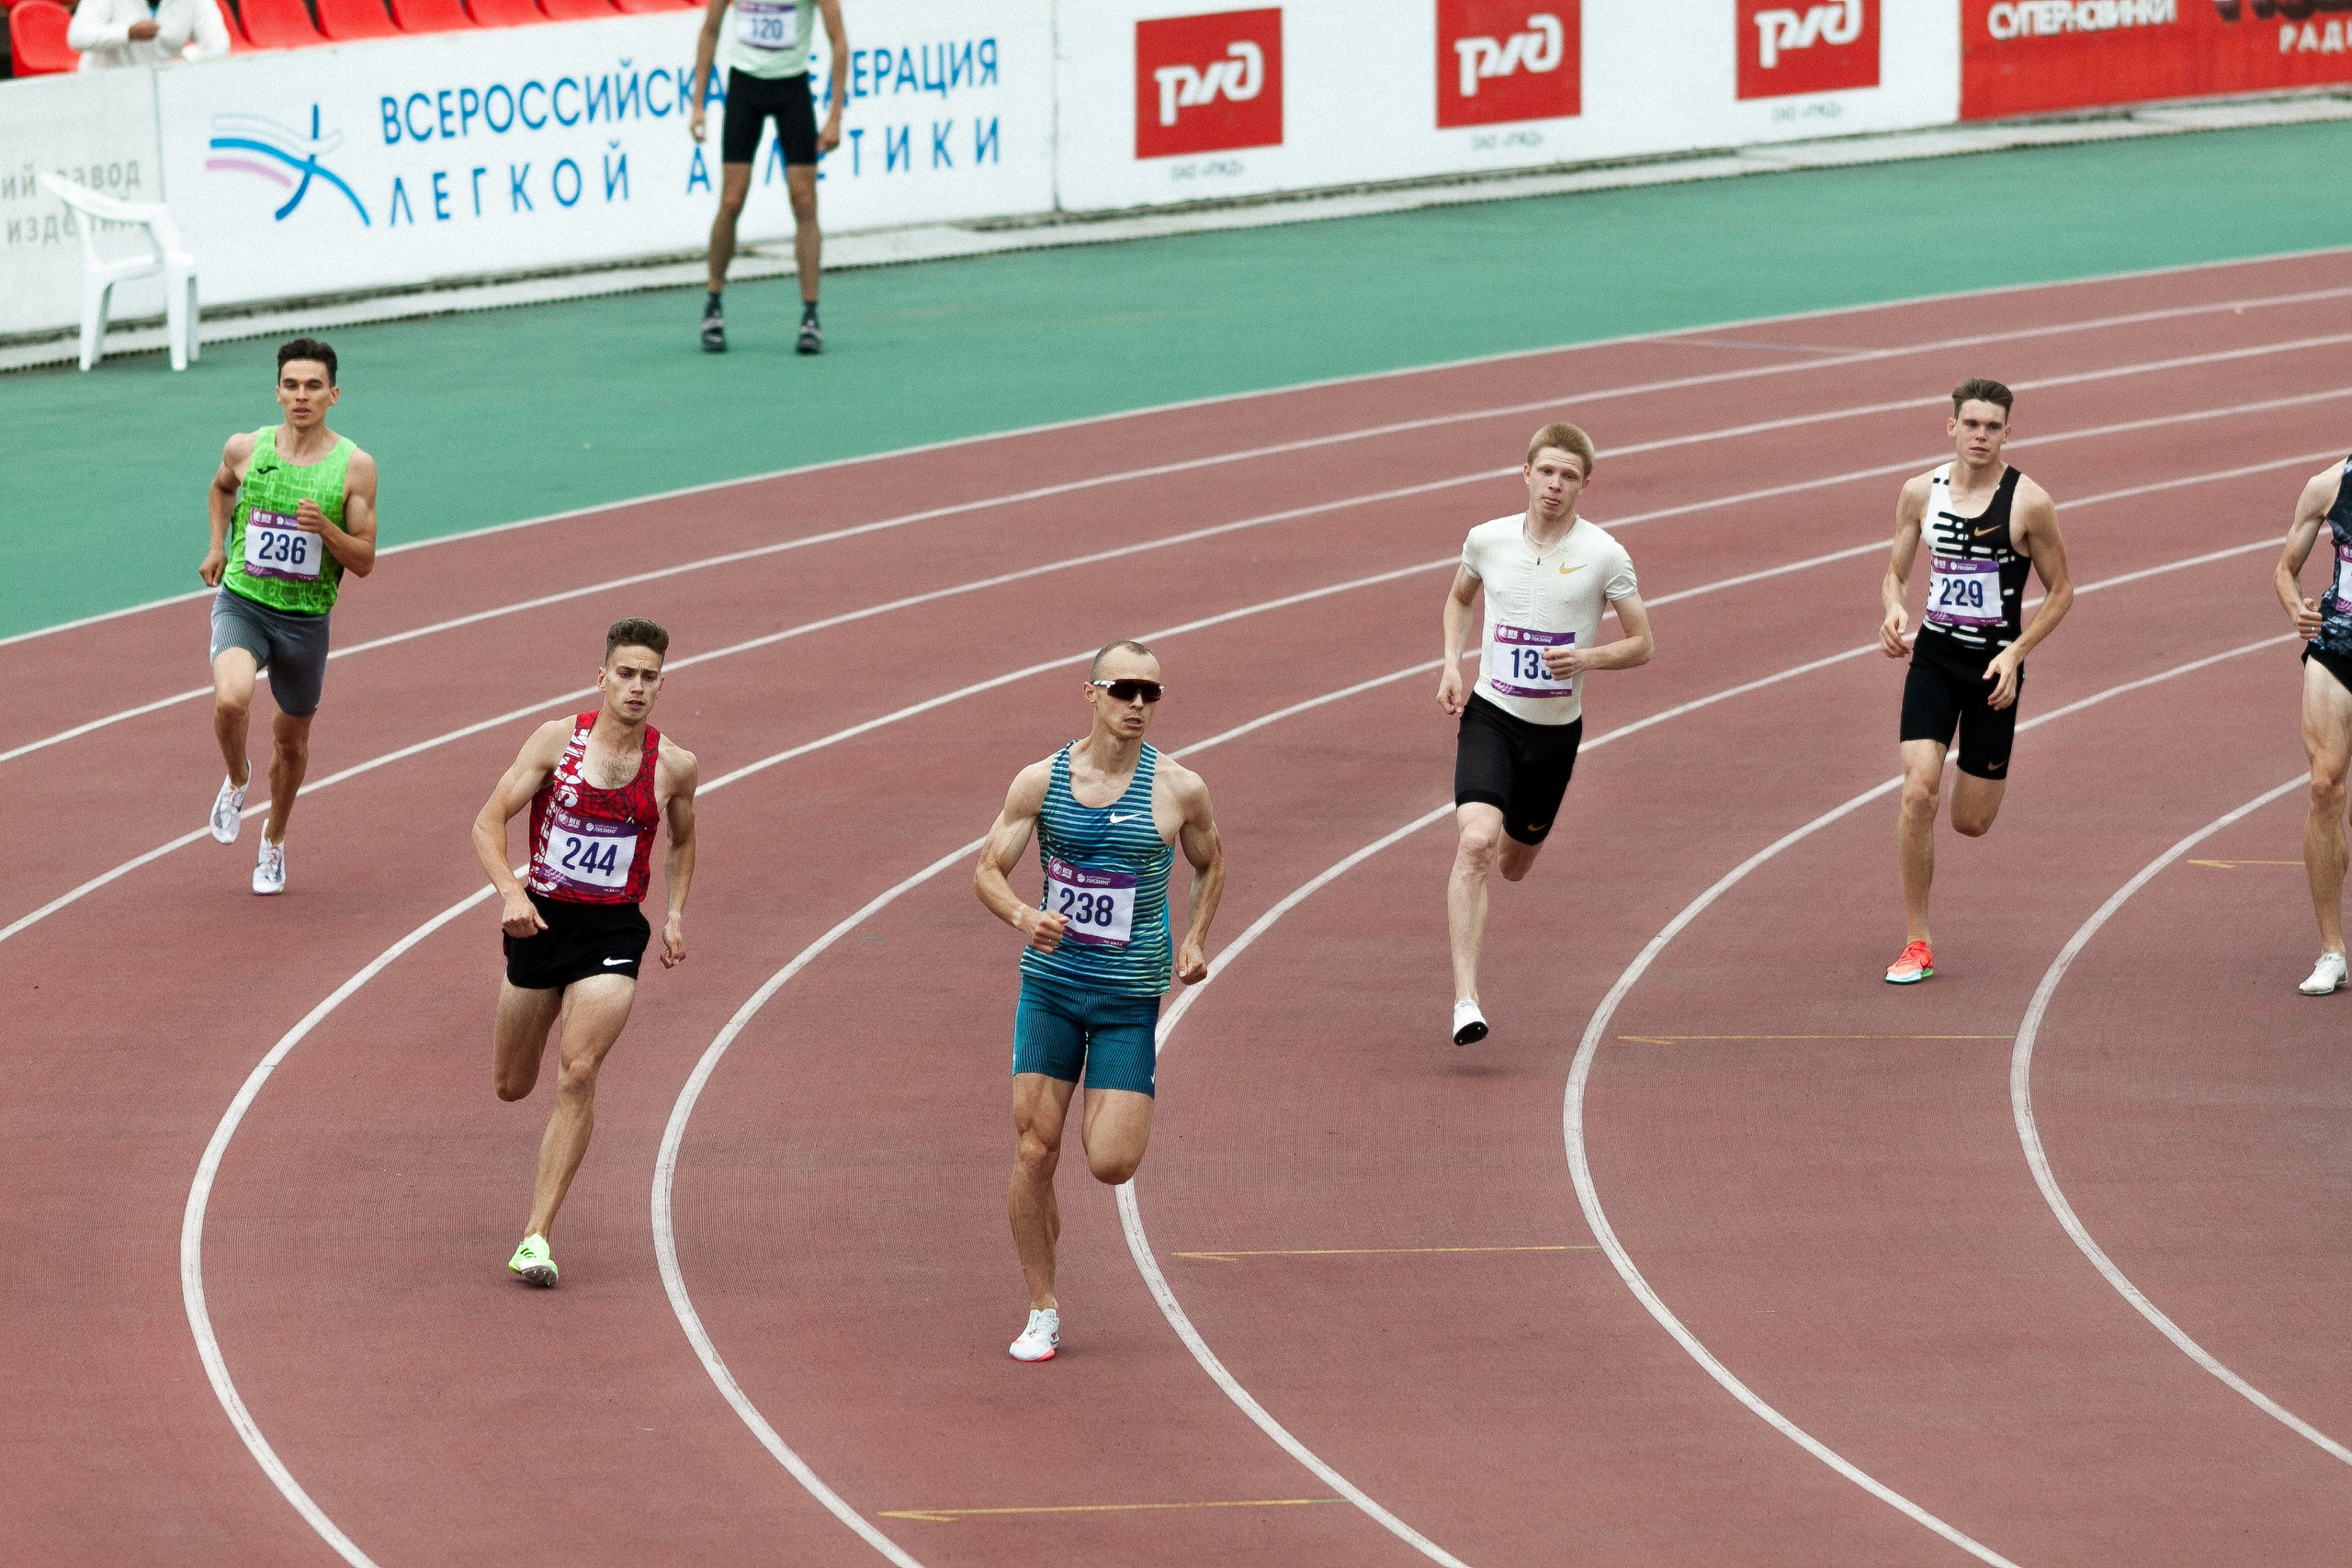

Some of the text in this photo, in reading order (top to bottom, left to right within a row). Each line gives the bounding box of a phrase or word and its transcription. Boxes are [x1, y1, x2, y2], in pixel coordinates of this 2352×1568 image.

[752, 17, 783, 39] 120
[382, 59, 728, 144] ВСЕРОССИЙСКА
[390, 117, 1000, 227] ЛЕГКОЙ АЛТИКИ
[258, 531, 307, 564] 236
[1939, 578, 1984, 608] 229
[561, 837, 617, 876] 244
[1059, 887, 1114, 927] 238
